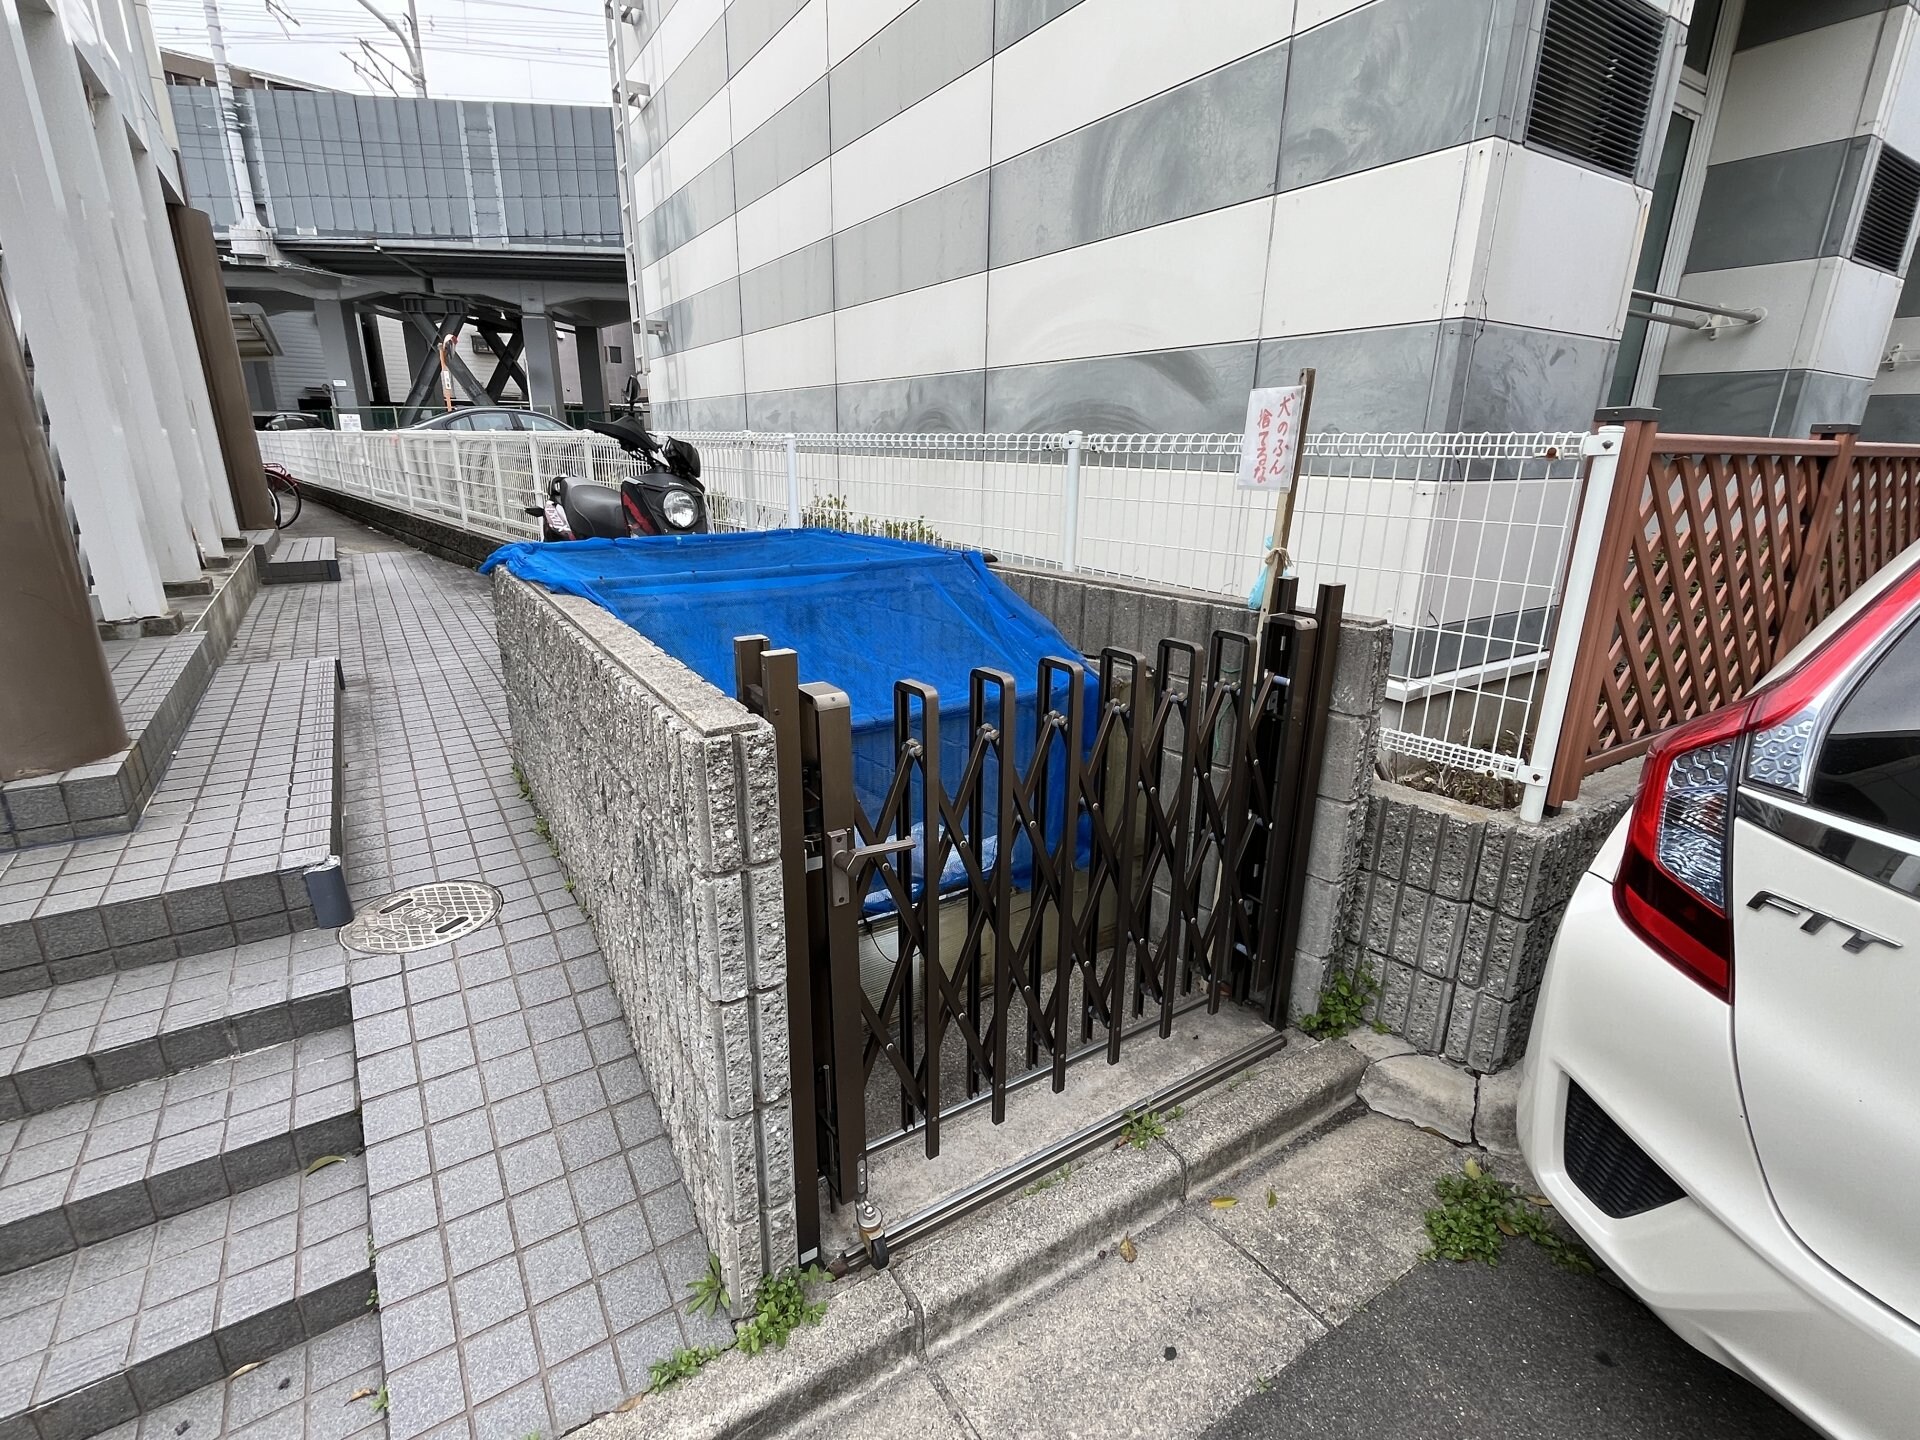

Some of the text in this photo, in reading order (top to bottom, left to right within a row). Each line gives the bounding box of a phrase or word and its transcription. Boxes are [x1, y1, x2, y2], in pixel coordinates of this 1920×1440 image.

[1253, 408, 1273, 484] 捨てるな
[1269, 393, 1295, 475] 犬のふん
[1746, 890, 1904, 954] FIT
